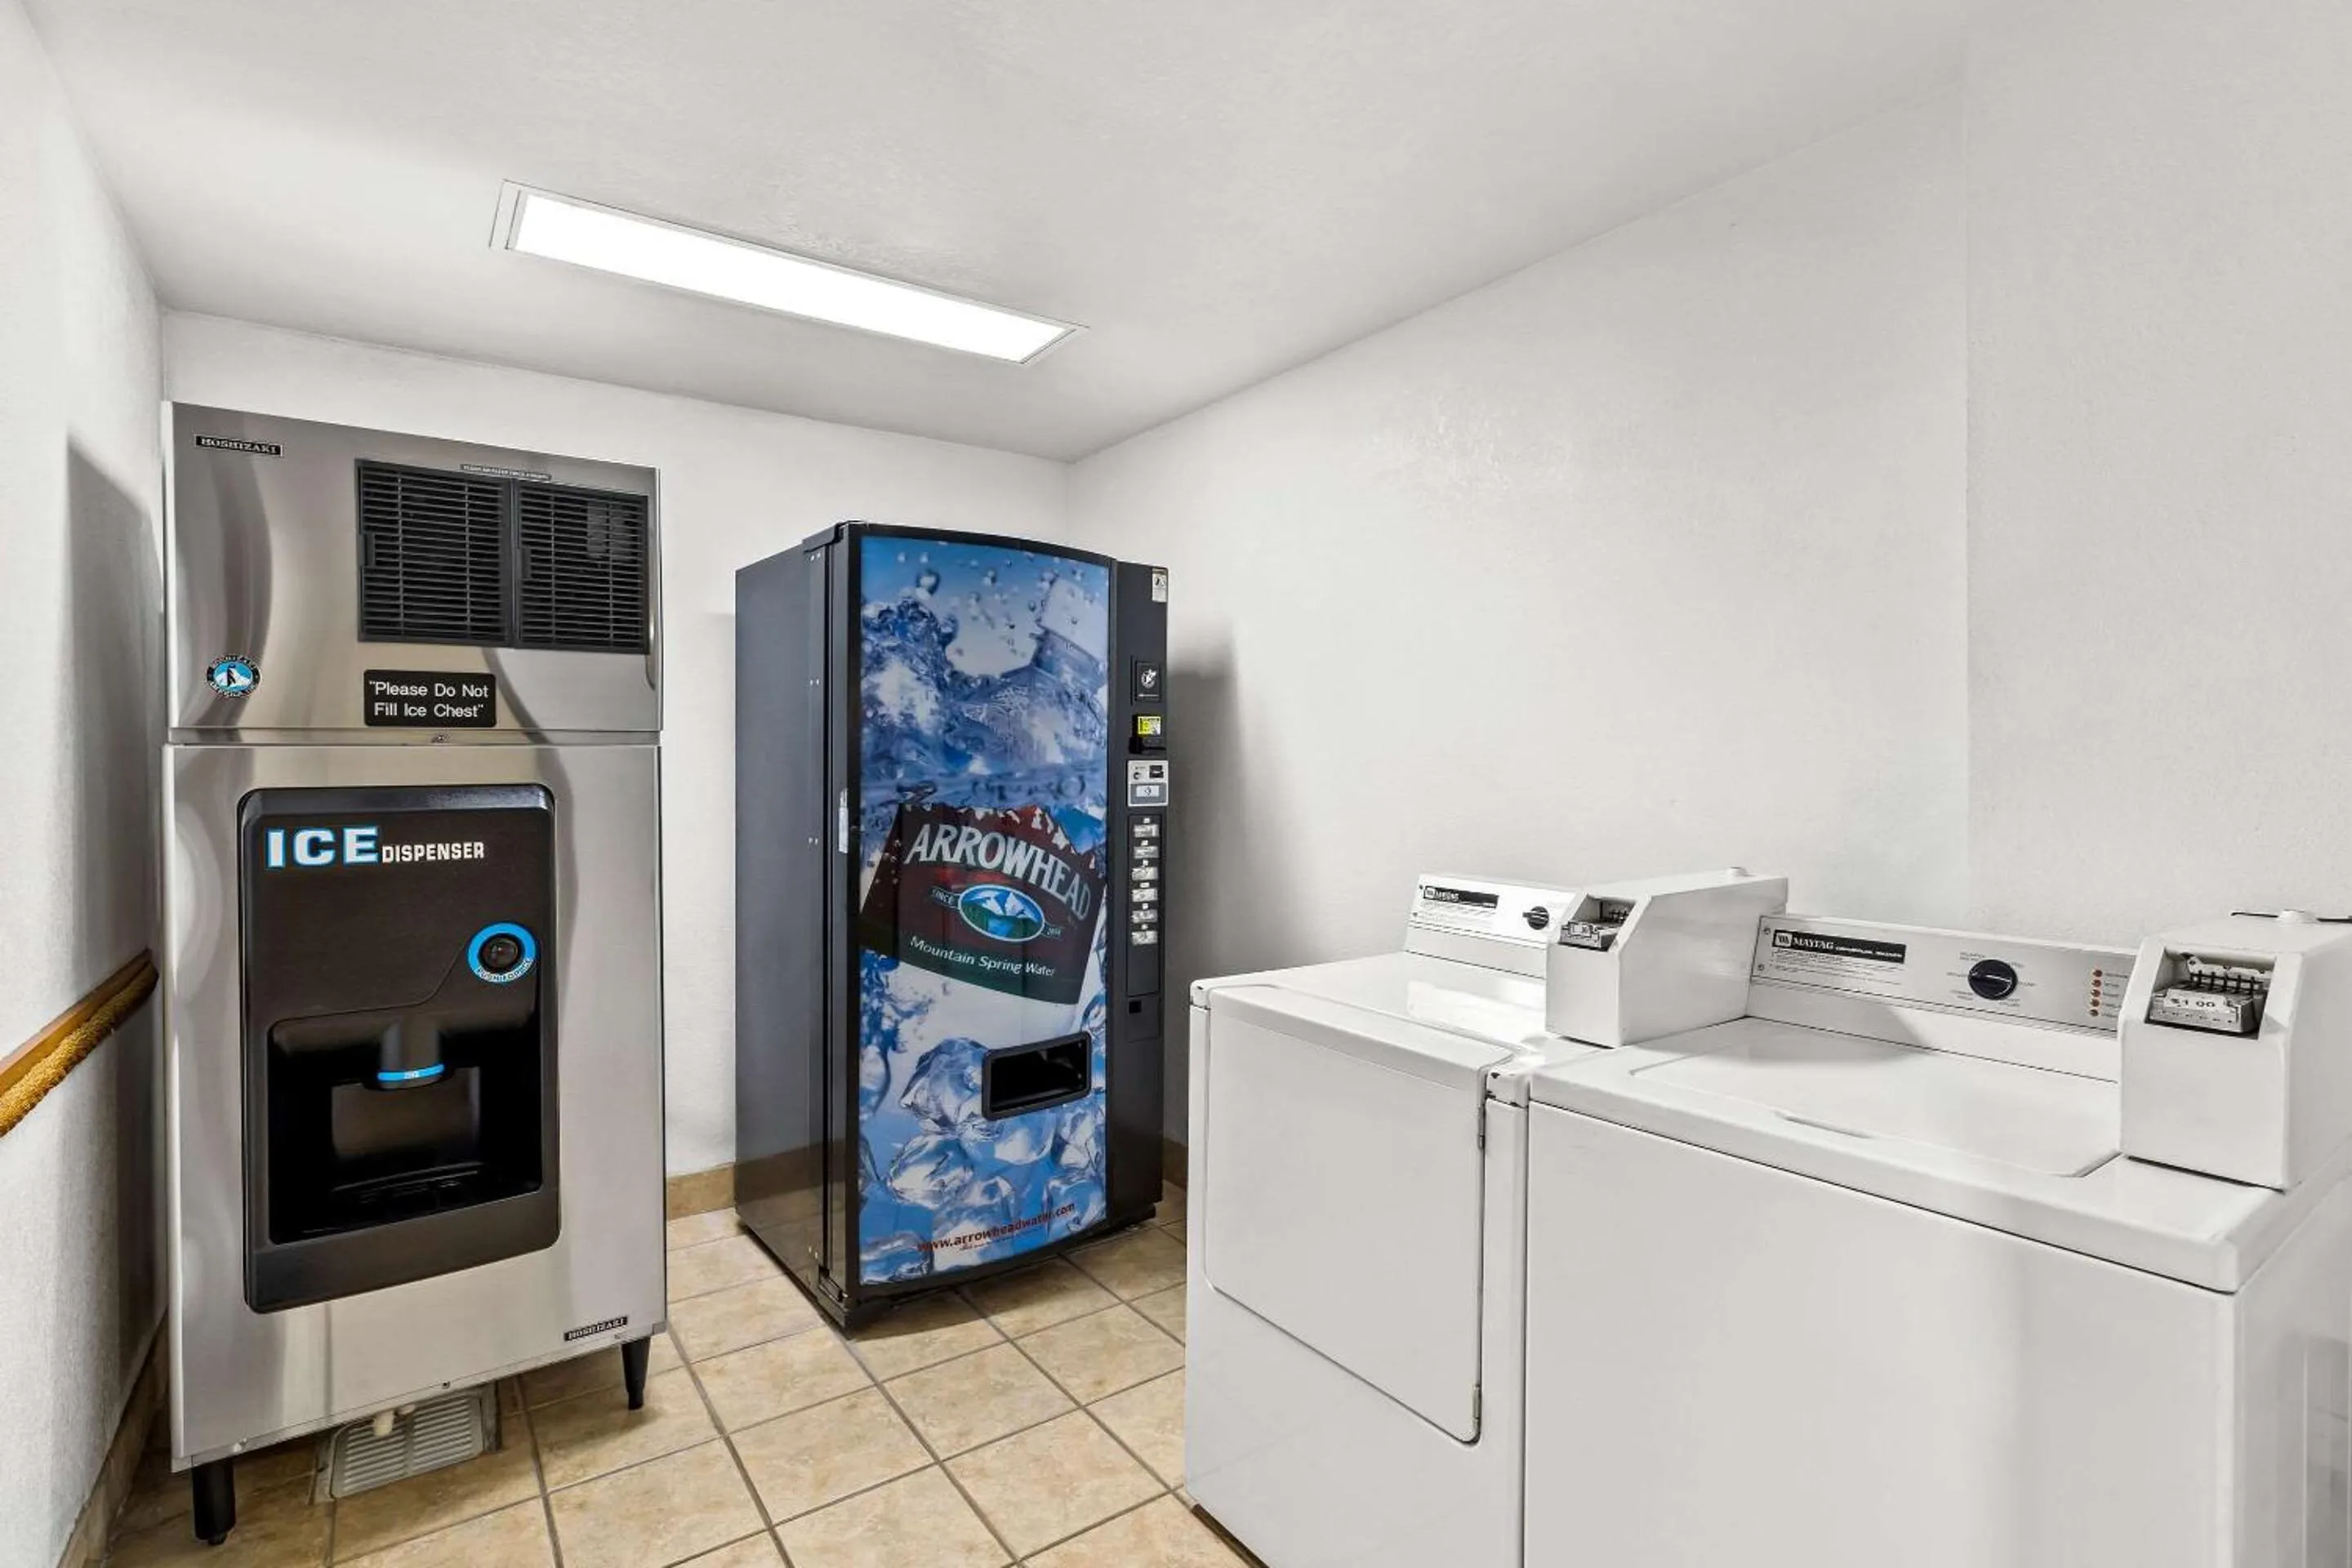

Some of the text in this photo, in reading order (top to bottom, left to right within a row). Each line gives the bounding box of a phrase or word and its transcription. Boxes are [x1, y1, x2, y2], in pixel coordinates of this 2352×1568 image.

[201, 438, 277, 453] HOSHIZAKI
[434, 683, 456, 697] Do
[462, 684, 489, 697] Not
[374, 702, 398, 716] Fill
[404, 703, 427, 716] Ice
[267, 826, 484, 869] ICE DISPENSER
[903, 823, 1092, 921] ARROWHEAD
[910, 936, 1055, 977] Mountain Spring Water
[1793, 937, 1834, 950] MAYTAG
[917, 1202, 1076, 1251] www.arrowheadwater.com
